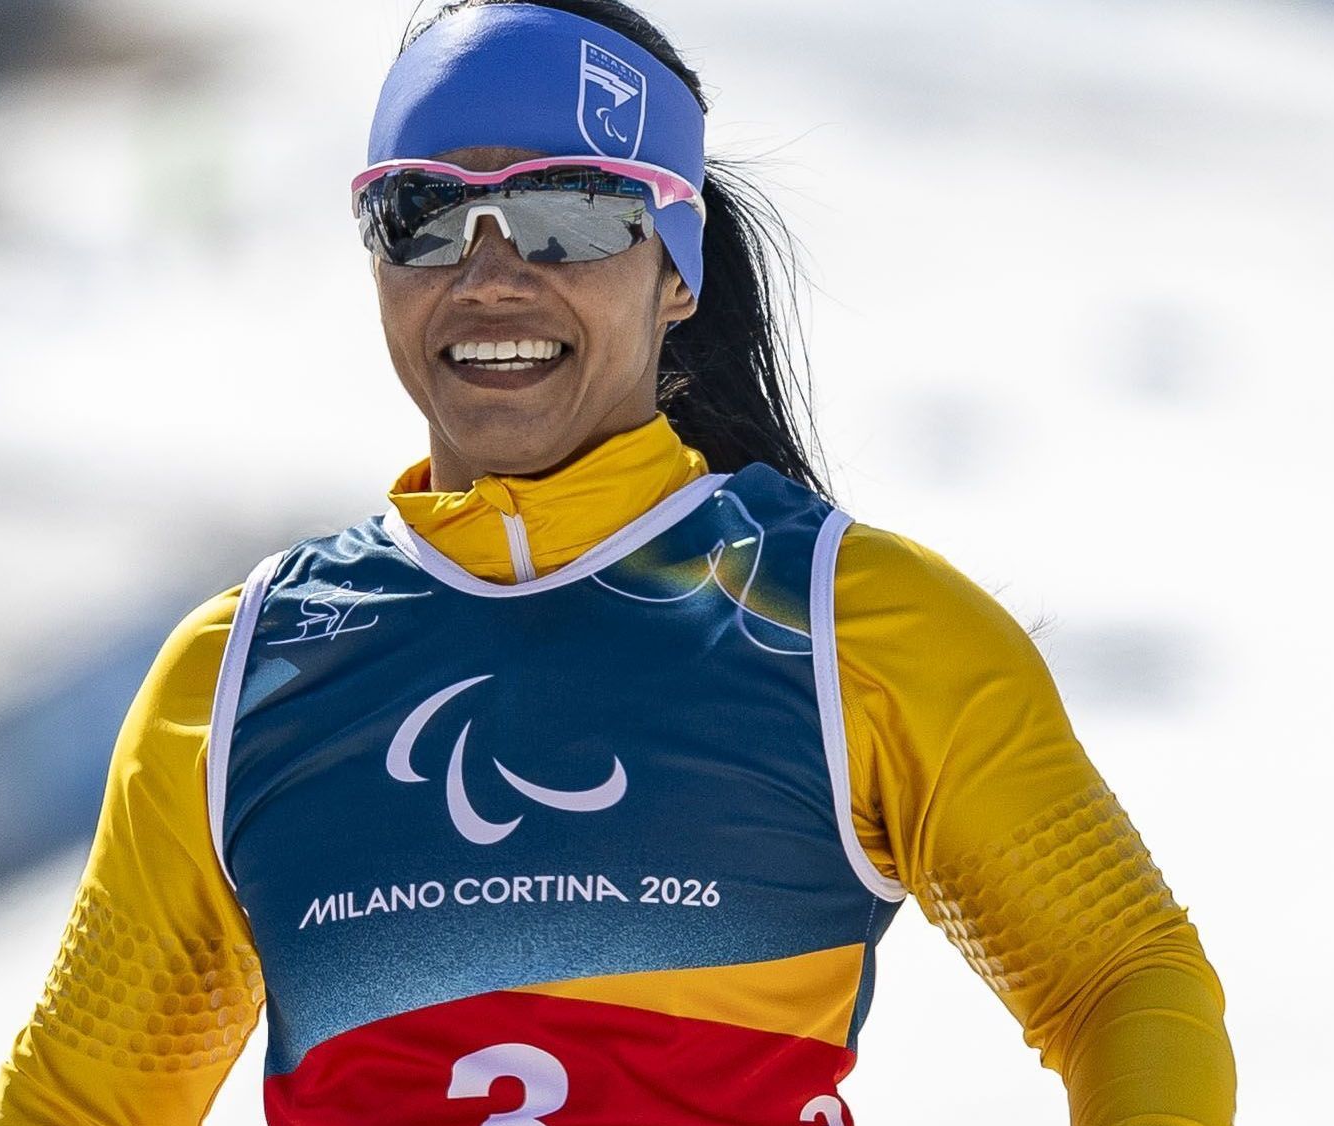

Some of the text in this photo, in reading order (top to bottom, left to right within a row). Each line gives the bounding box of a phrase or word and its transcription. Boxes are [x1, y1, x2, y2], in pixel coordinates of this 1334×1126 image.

[589, 48, 640, 84] BRASIL
[298, 875, 721, 930] MILANO CORTINA 2026
